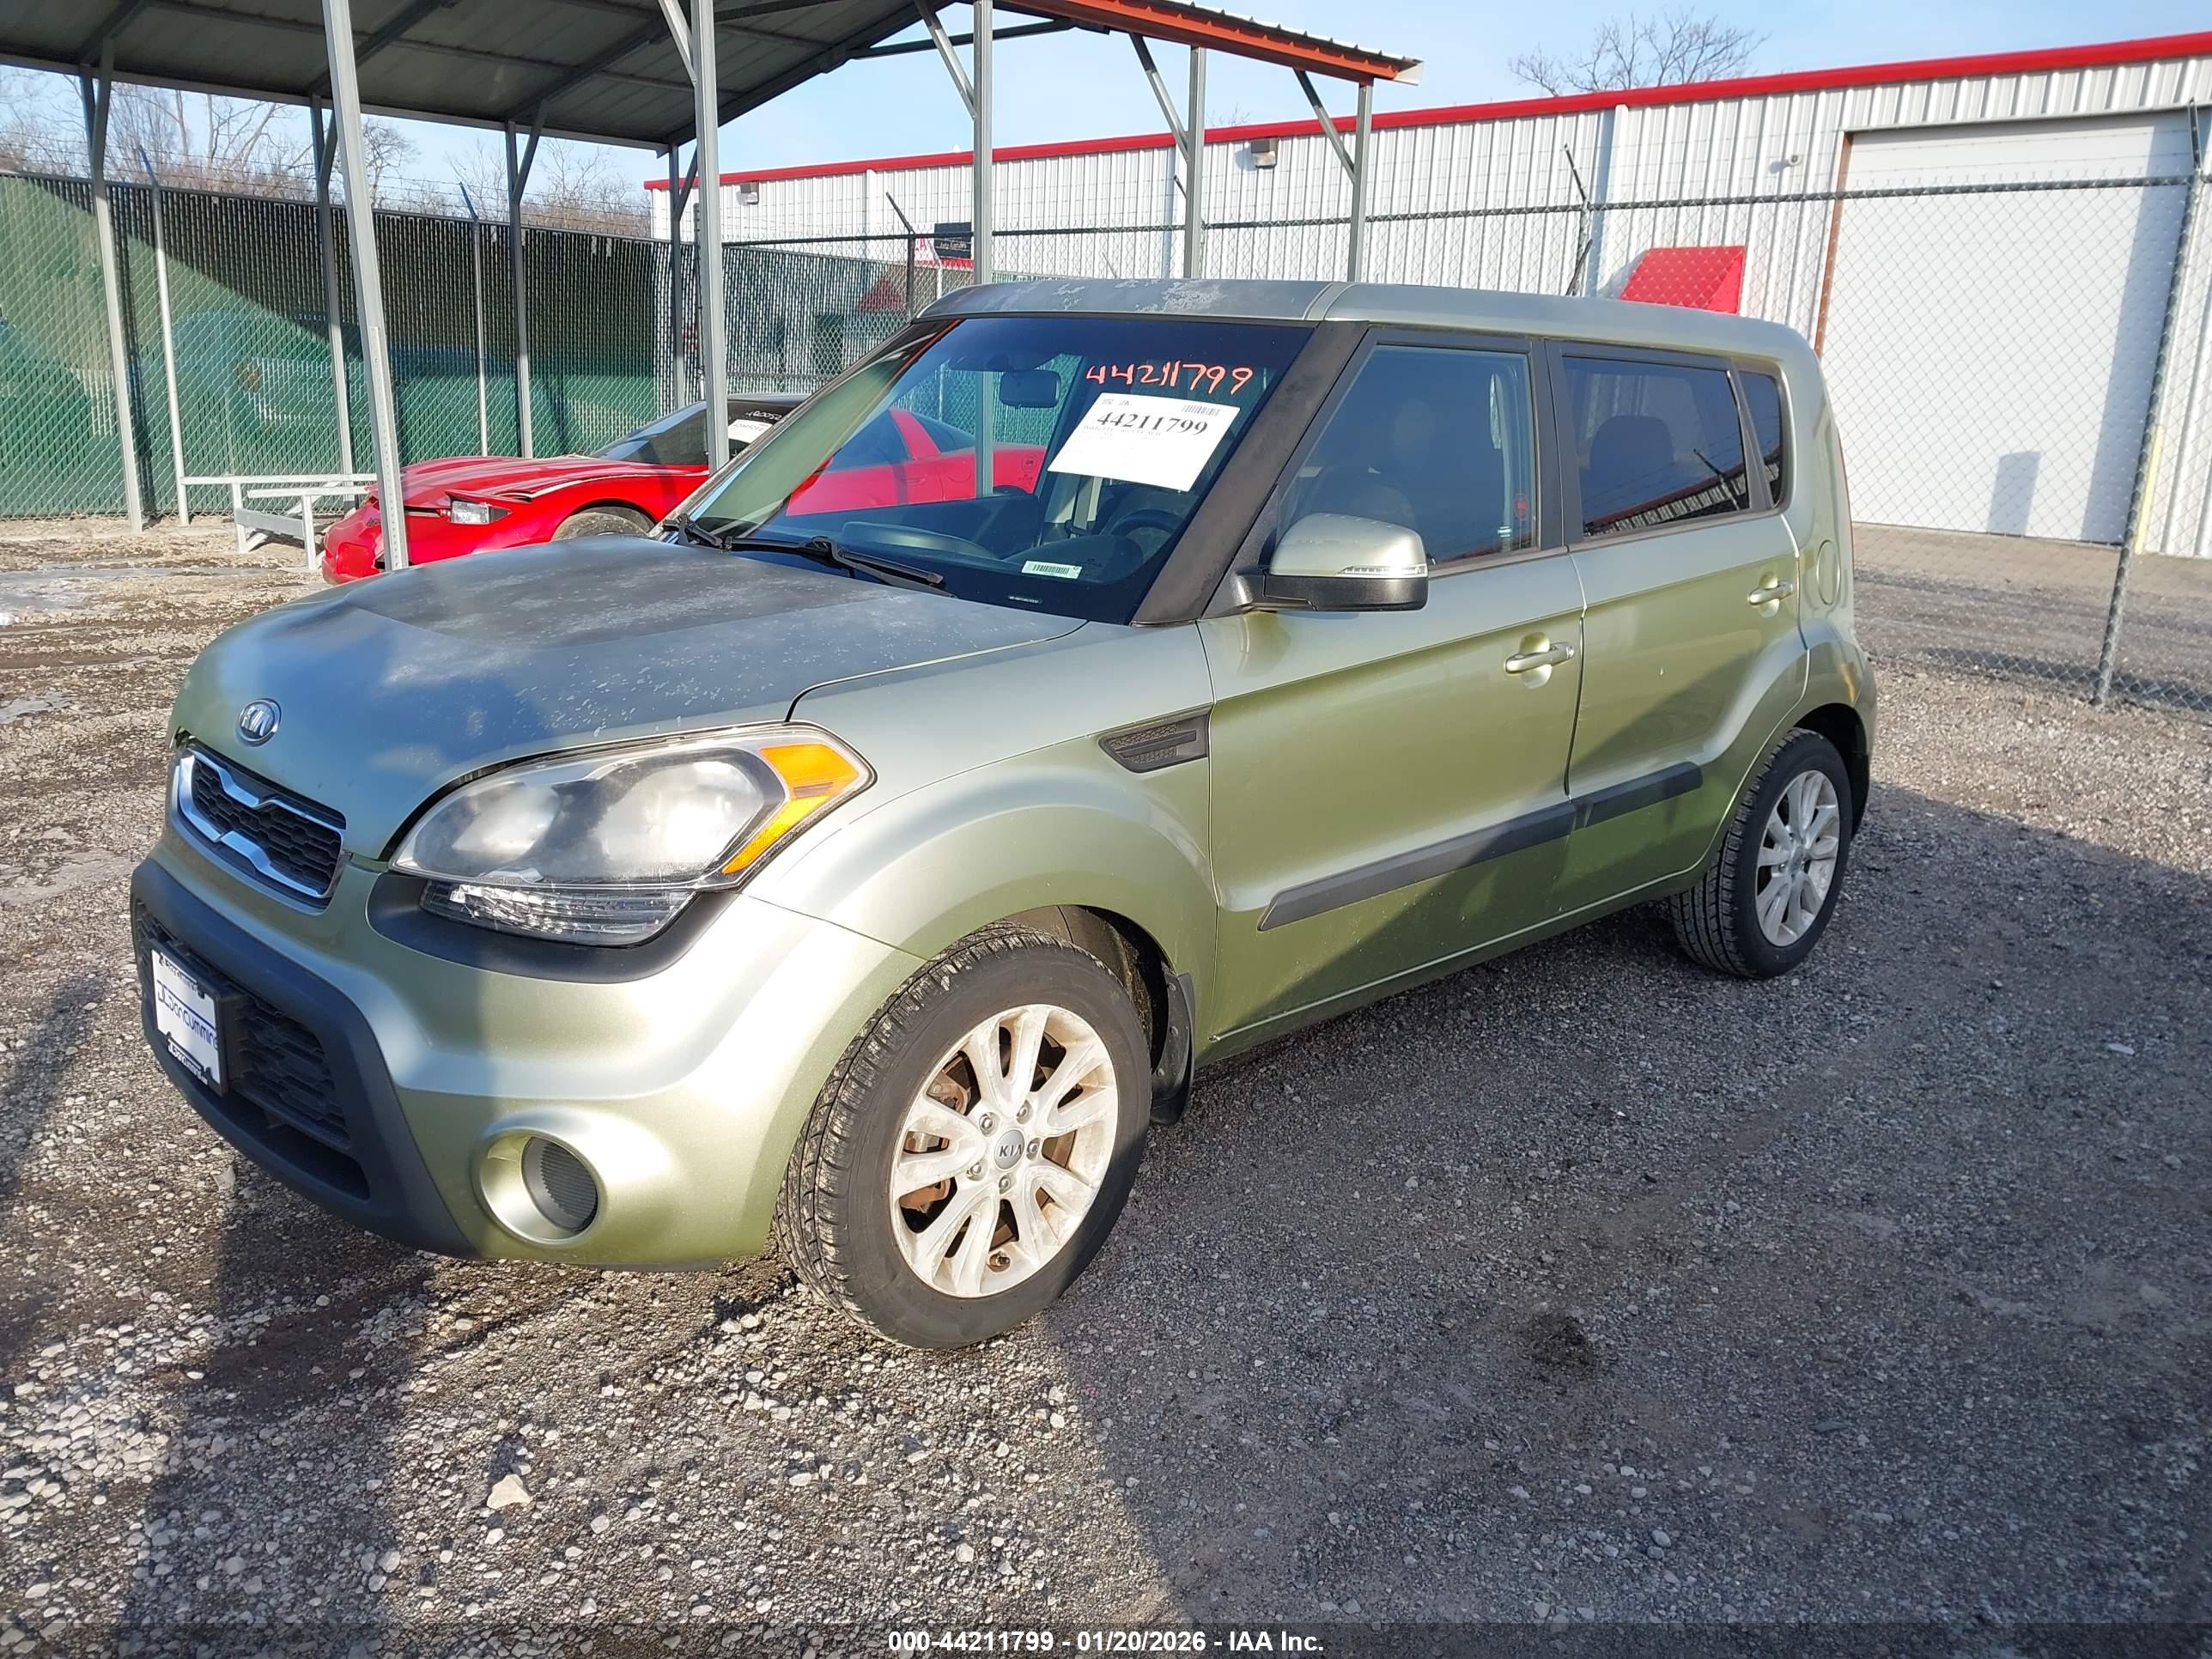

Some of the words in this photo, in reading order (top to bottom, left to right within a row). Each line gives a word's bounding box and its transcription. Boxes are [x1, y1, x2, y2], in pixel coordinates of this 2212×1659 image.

[1085, 359, 1255, 396] 44211799
[1097, 411, 1208, 435] 44211799
[241, 705, 272, 737] KIA
[999, 1144, 1023, 1158] KIA
